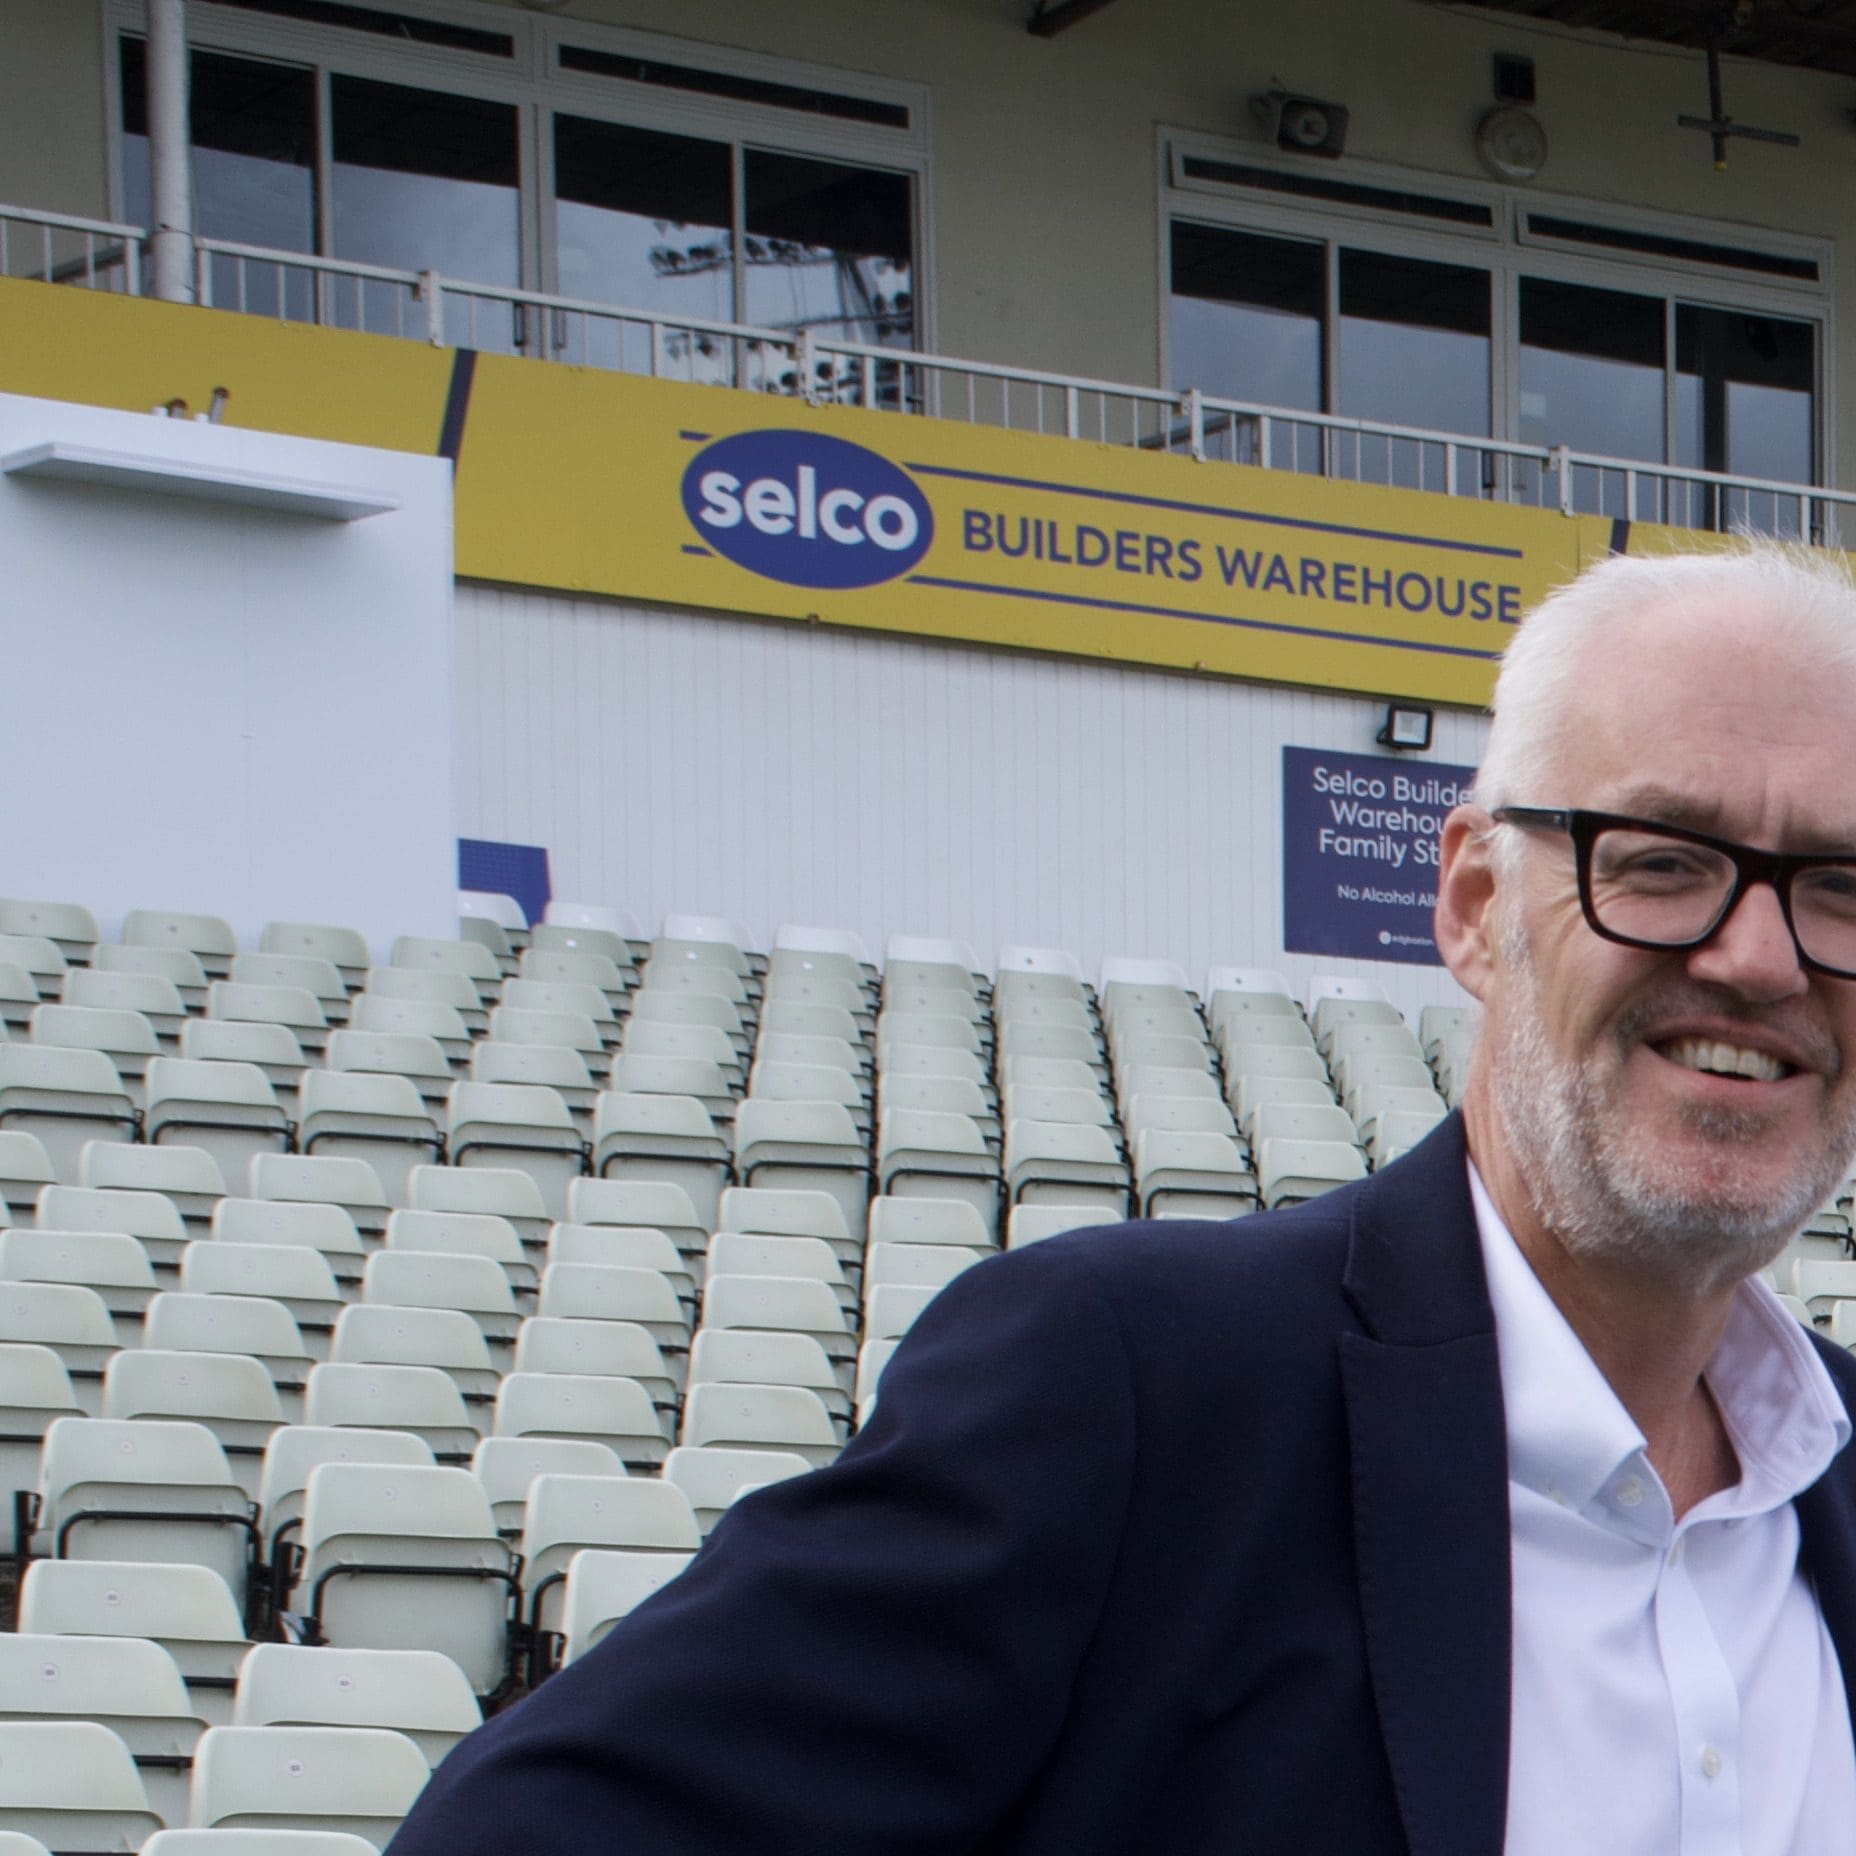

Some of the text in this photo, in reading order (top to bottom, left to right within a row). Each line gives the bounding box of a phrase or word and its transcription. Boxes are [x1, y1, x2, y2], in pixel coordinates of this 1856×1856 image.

[699, 466, 919, 551] selco
[963, 509, 1520, 624] BUILDERS WAREHOUSE
[1313, 767, 1473, 807] Selco Builde
[1330, 800, 1444, 834] Warehou
[1319, 829, 1407, 868] Family
[1338, 884, 1358, 900] No
[1362, 887, 1415, 905] Alcohol
